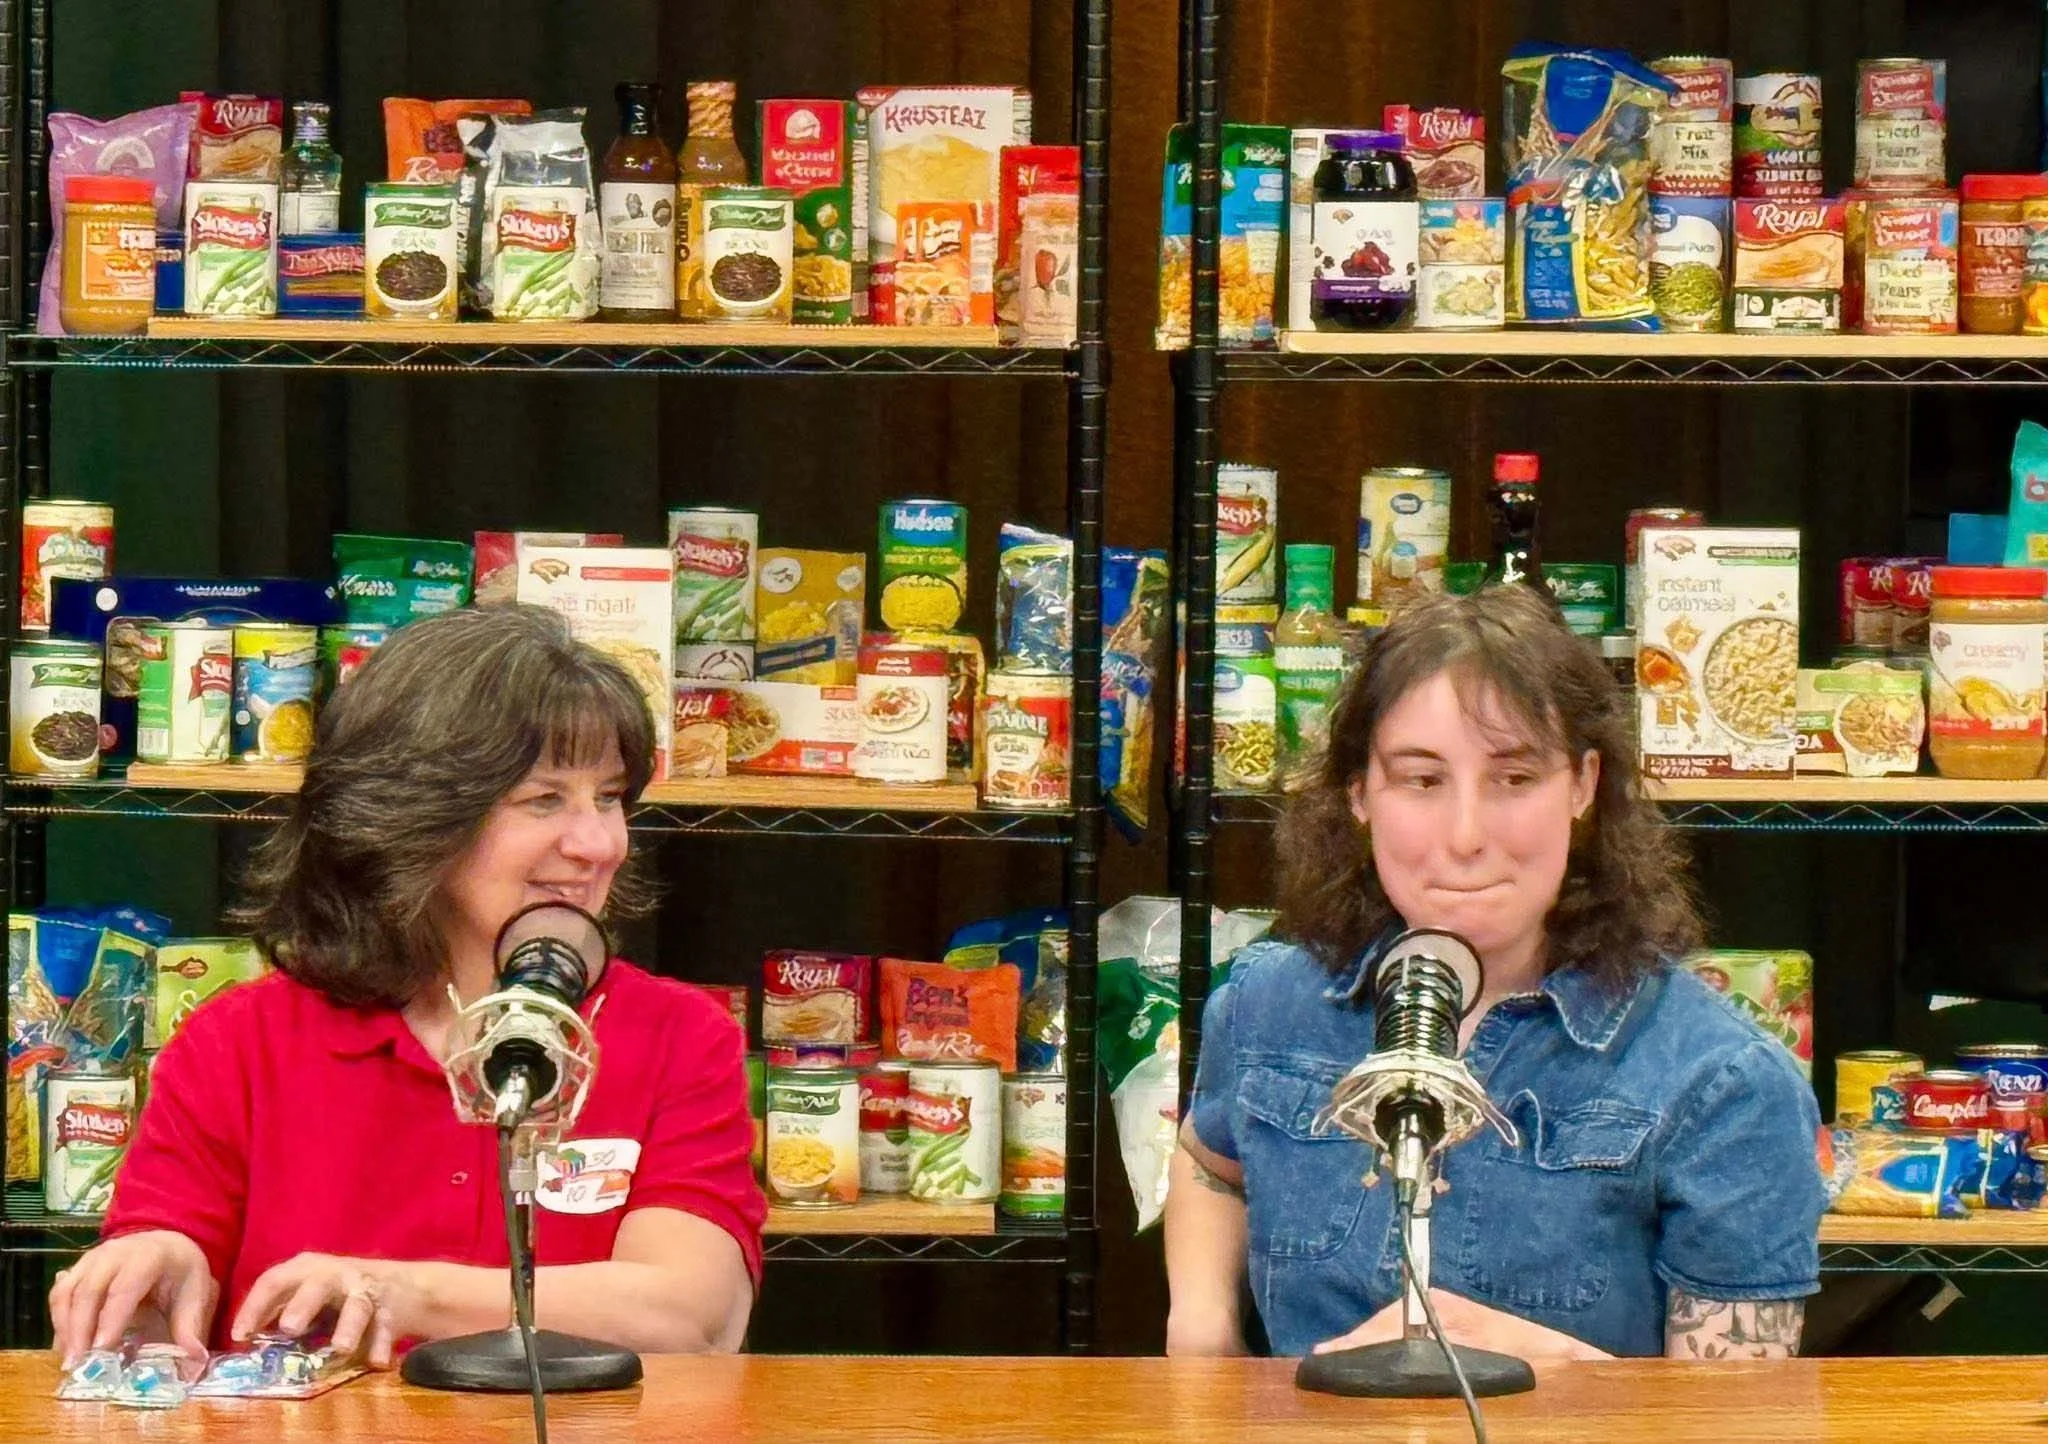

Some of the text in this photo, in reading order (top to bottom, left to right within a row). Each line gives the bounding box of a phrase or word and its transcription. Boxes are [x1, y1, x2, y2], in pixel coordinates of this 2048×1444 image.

[884, 104, 987, 132] KRUSTEAZ
[1753, 205, 1828, 234] Royal
[1879, 283, 1921, 299] Pears
[777, 958, 842, 993] Royal
